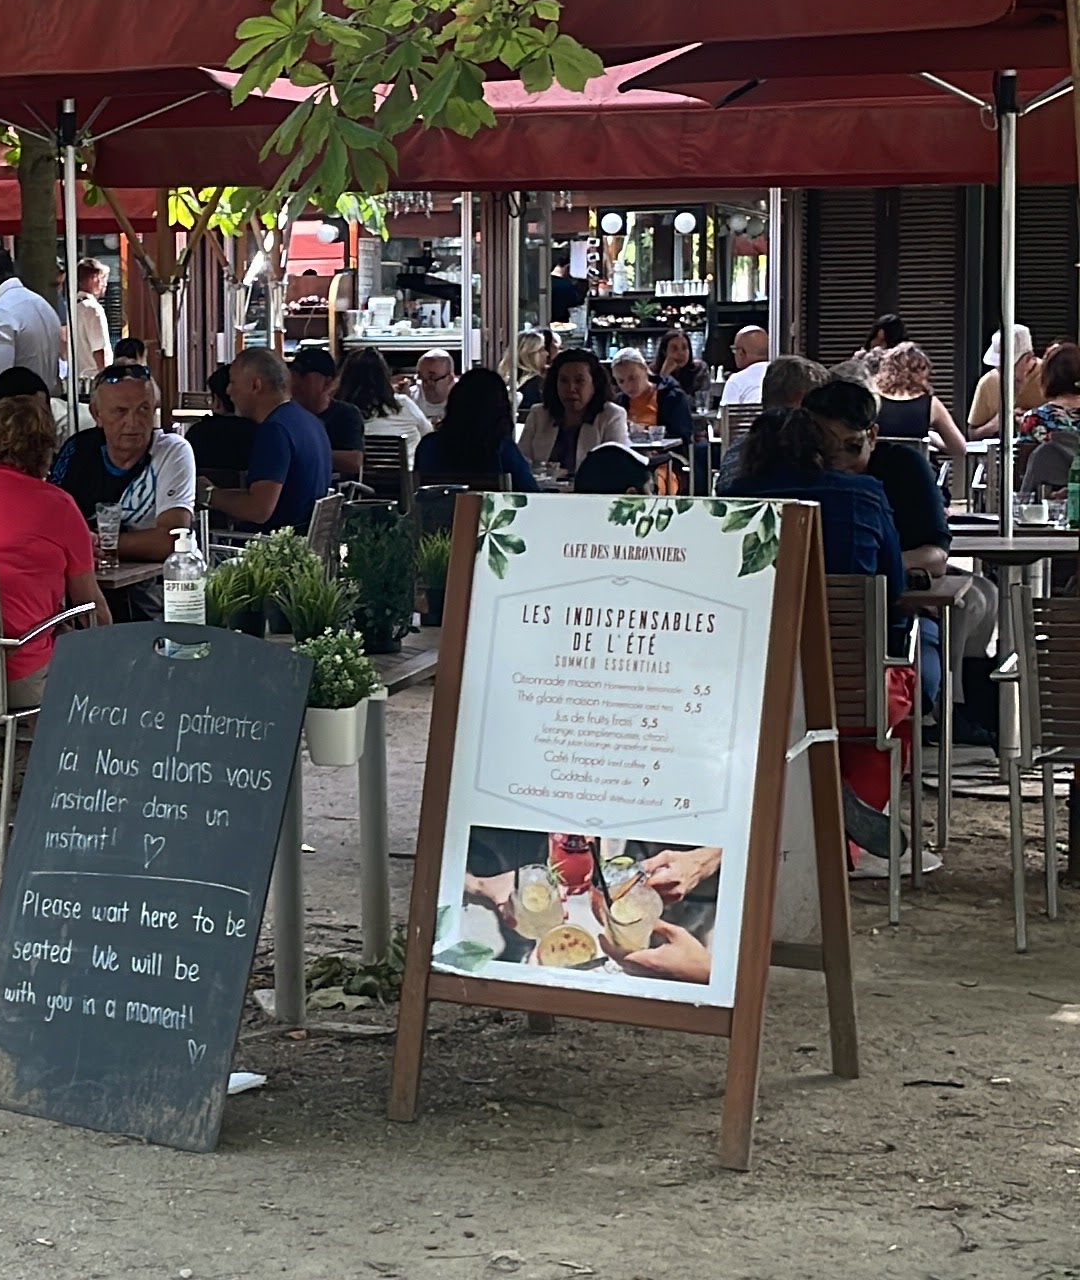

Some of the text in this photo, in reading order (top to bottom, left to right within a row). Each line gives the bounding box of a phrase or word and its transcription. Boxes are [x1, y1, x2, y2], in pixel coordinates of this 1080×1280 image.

[563, 542, 687, 563] CAFE DES MARRONNIERS
[522, 604, 716, 634] LES INDISPENSABLES
[573, 632, 657, 656] DE L'ÉTÉ
[554, 654, 671, 675] SUMMER ESSENTIALS
[693, 684, 711, 697] 5,5
[683, 702, 702, 715] 5,5
[67, 693, 128, 726] Merci
[176, 704, 275, 753] patienter
[640, 716, 659, 730] 5,5
[94, 748, 140, 777] Nous
[151, 755, 213, 784] allons
[226, 766, 273, 791] vous
[653, 760, 661, 771] 6
[642, 776, 650, 787] 9
[50, 786, 231, 827] installer dans un
[674, 797, 691, 810] 7,8
[21, 889, 248, 938] Please wait here to be
[12, 939, 201, 982] seated We will be
[4, 980, 37, 1005] with
[46, 992, 74, 1023] you
[82, 994, 97, 1015] in
[104, 998, 117, 1020] a
